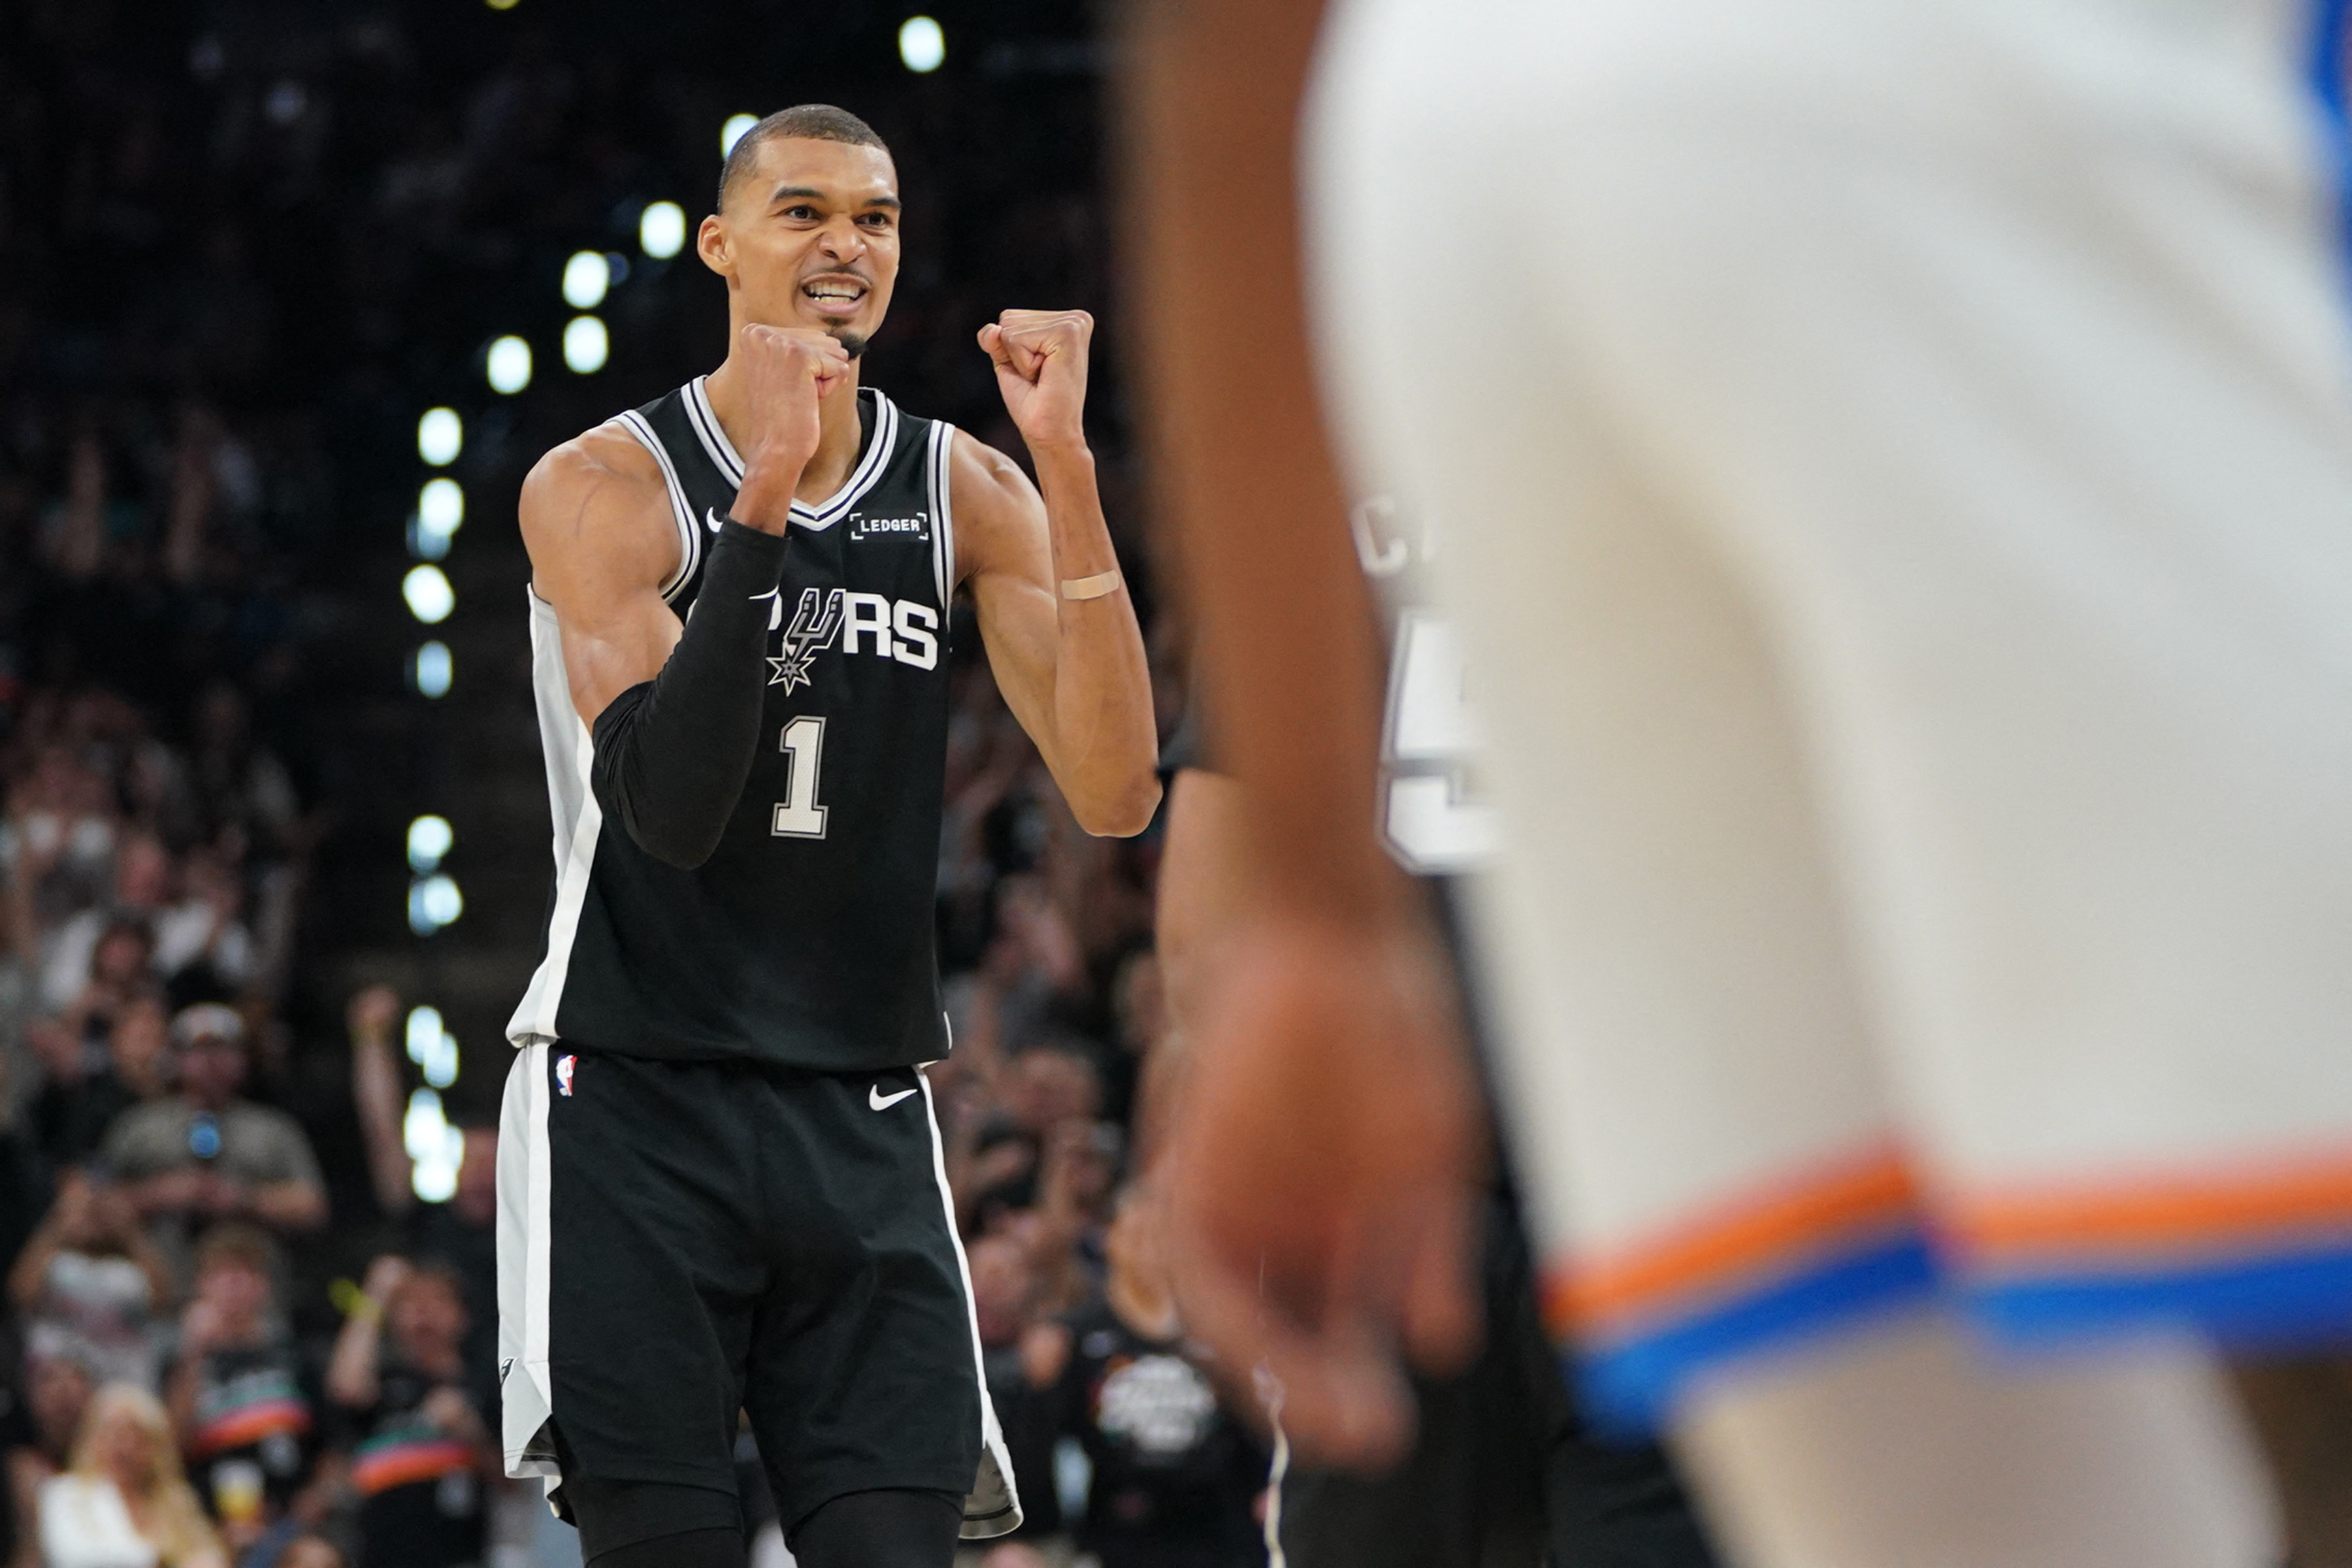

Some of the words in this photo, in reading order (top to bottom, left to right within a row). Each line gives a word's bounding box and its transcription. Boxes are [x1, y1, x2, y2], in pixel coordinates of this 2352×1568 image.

[860, 519, 921, 532] LEDGER
[766, 587, 939, 697] URS
[770, 715, 829, 840] 1
